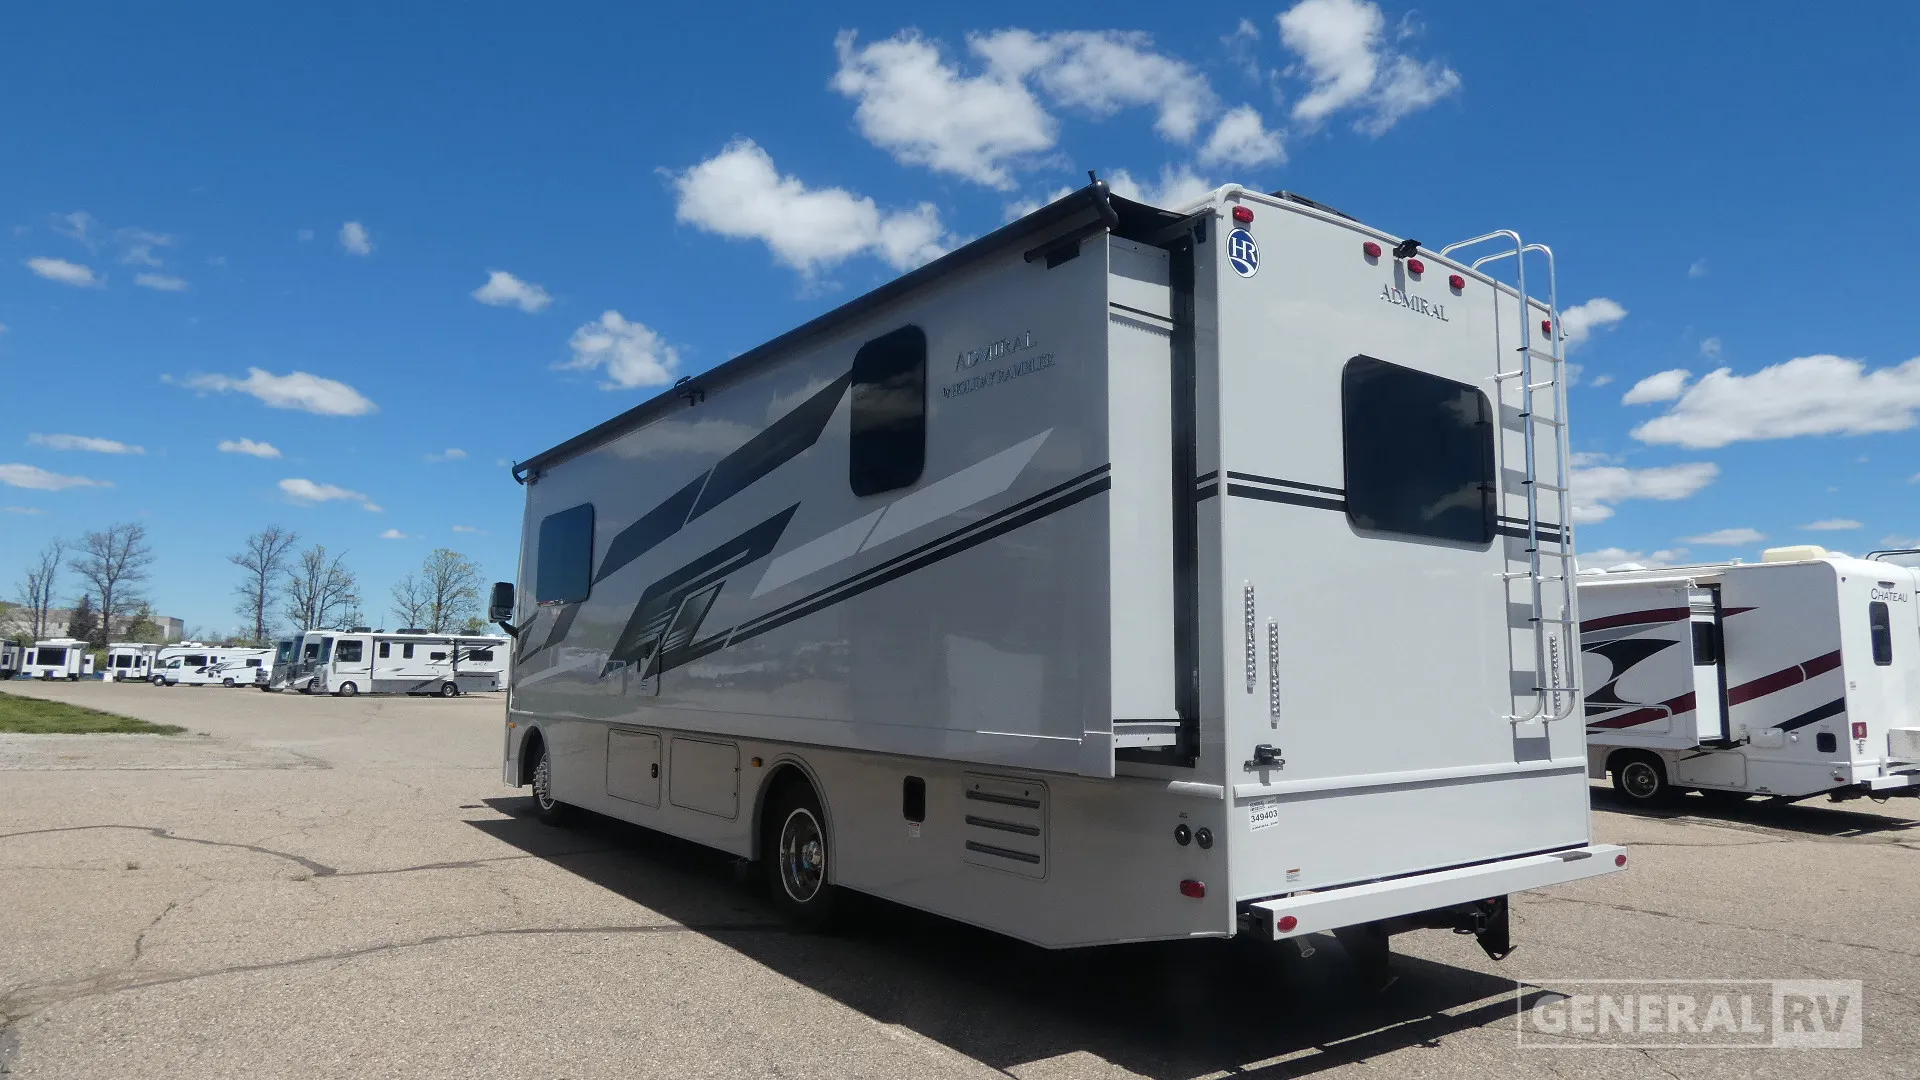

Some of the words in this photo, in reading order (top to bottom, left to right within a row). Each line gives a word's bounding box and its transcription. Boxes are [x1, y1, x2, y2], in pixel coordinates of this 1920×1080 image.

[1231, 236, 1258, 263] HR
[1380, 284, 1449, 322] ADMIRAL
[954, 328, 1038, 372] ADMIRAL
[1870, 587, 1908, 603] CHATEAU
[1250, 809, 1278, 823] 349403
